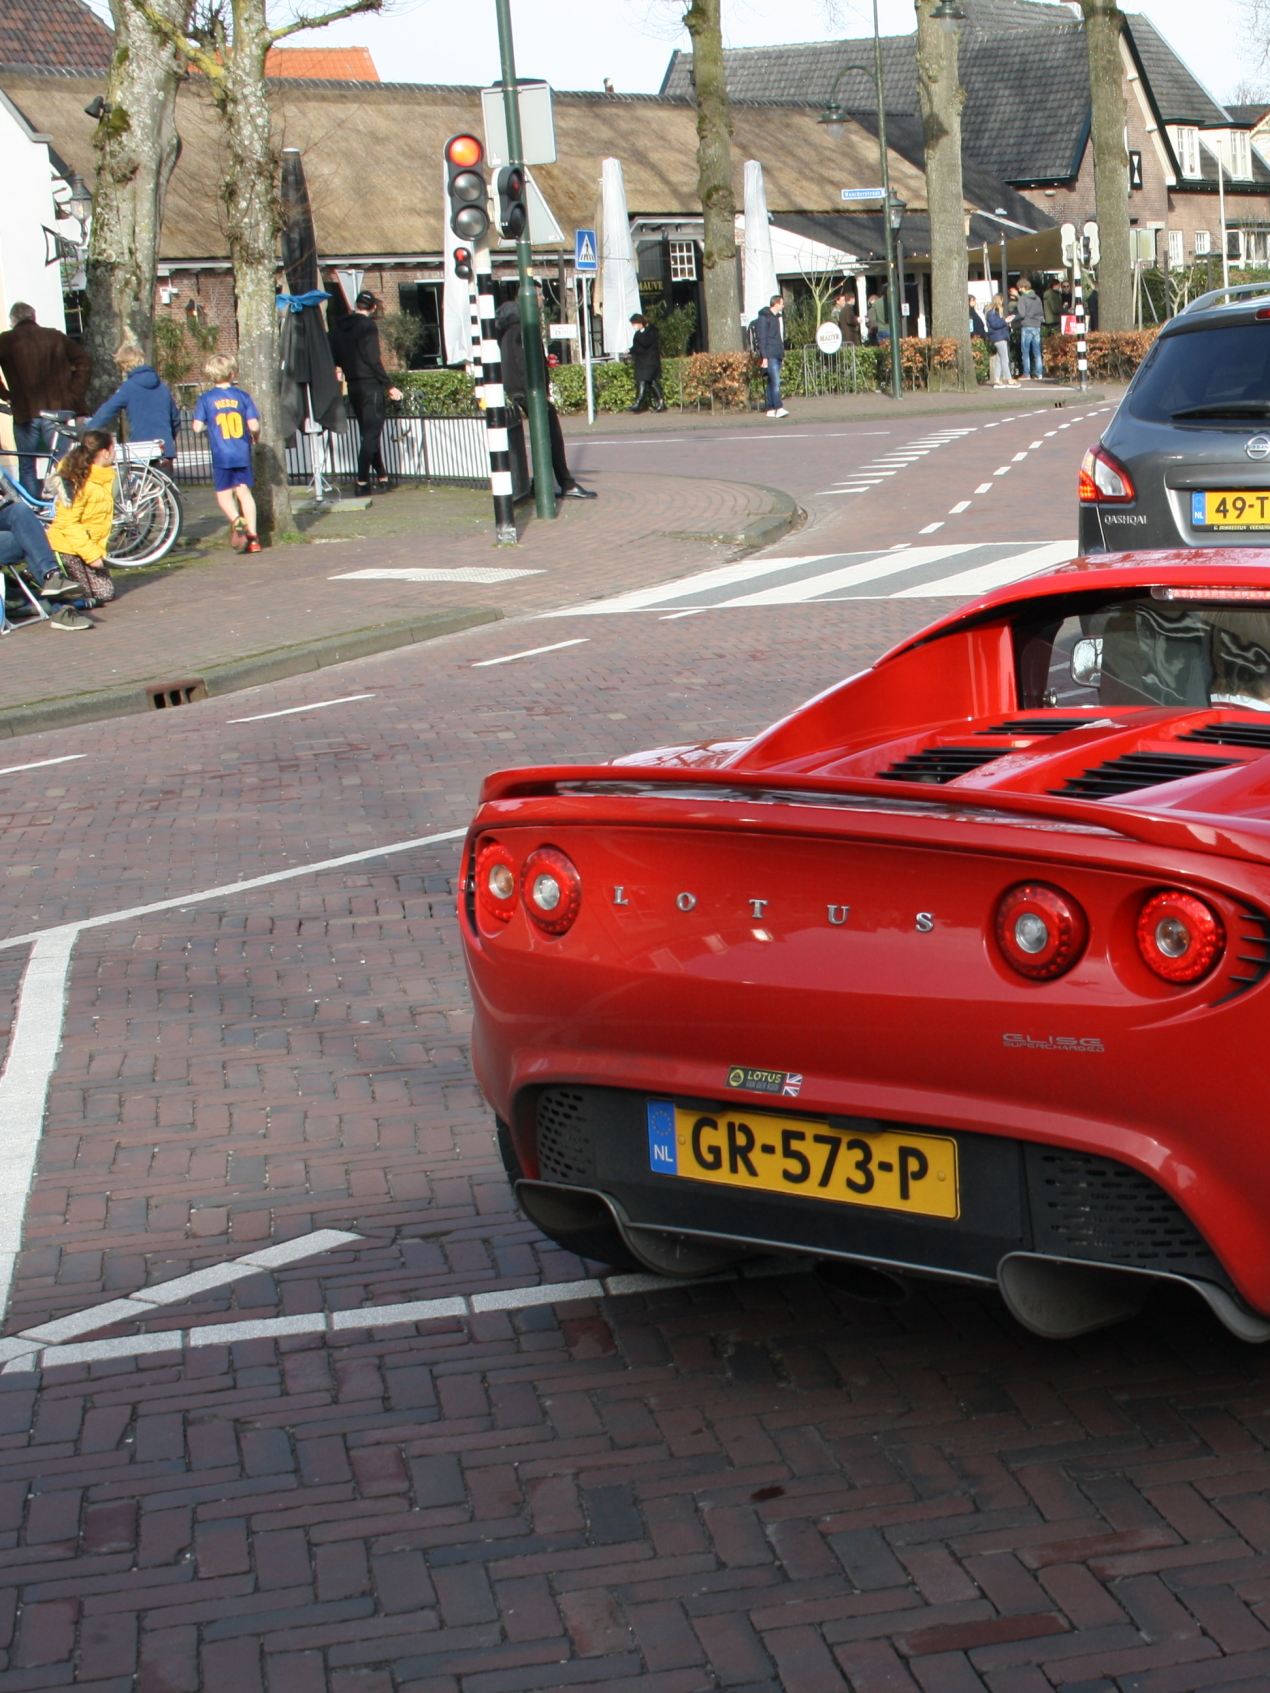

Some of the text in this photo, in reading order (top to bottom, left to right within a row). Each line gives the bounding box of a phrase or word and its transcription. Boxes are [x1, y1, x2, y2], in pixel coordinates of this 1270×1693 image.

[214, 398, 239, 410] MESSI
[215, 411, 244, 440] 10
[1104, 514, 1147, 526] QASHQAI
[1194, 511, 1204, 519] NL
[613, 886, 935, 932] LOTUS
[1002, 1033, 1104, 1047] ELISE
[1003, 1041, 1105, 1053] SUPERCHARGED
[747, 1070, 782, 1083] LOTUS
[654, 1116, 929, 1201] NL GR-573-P
